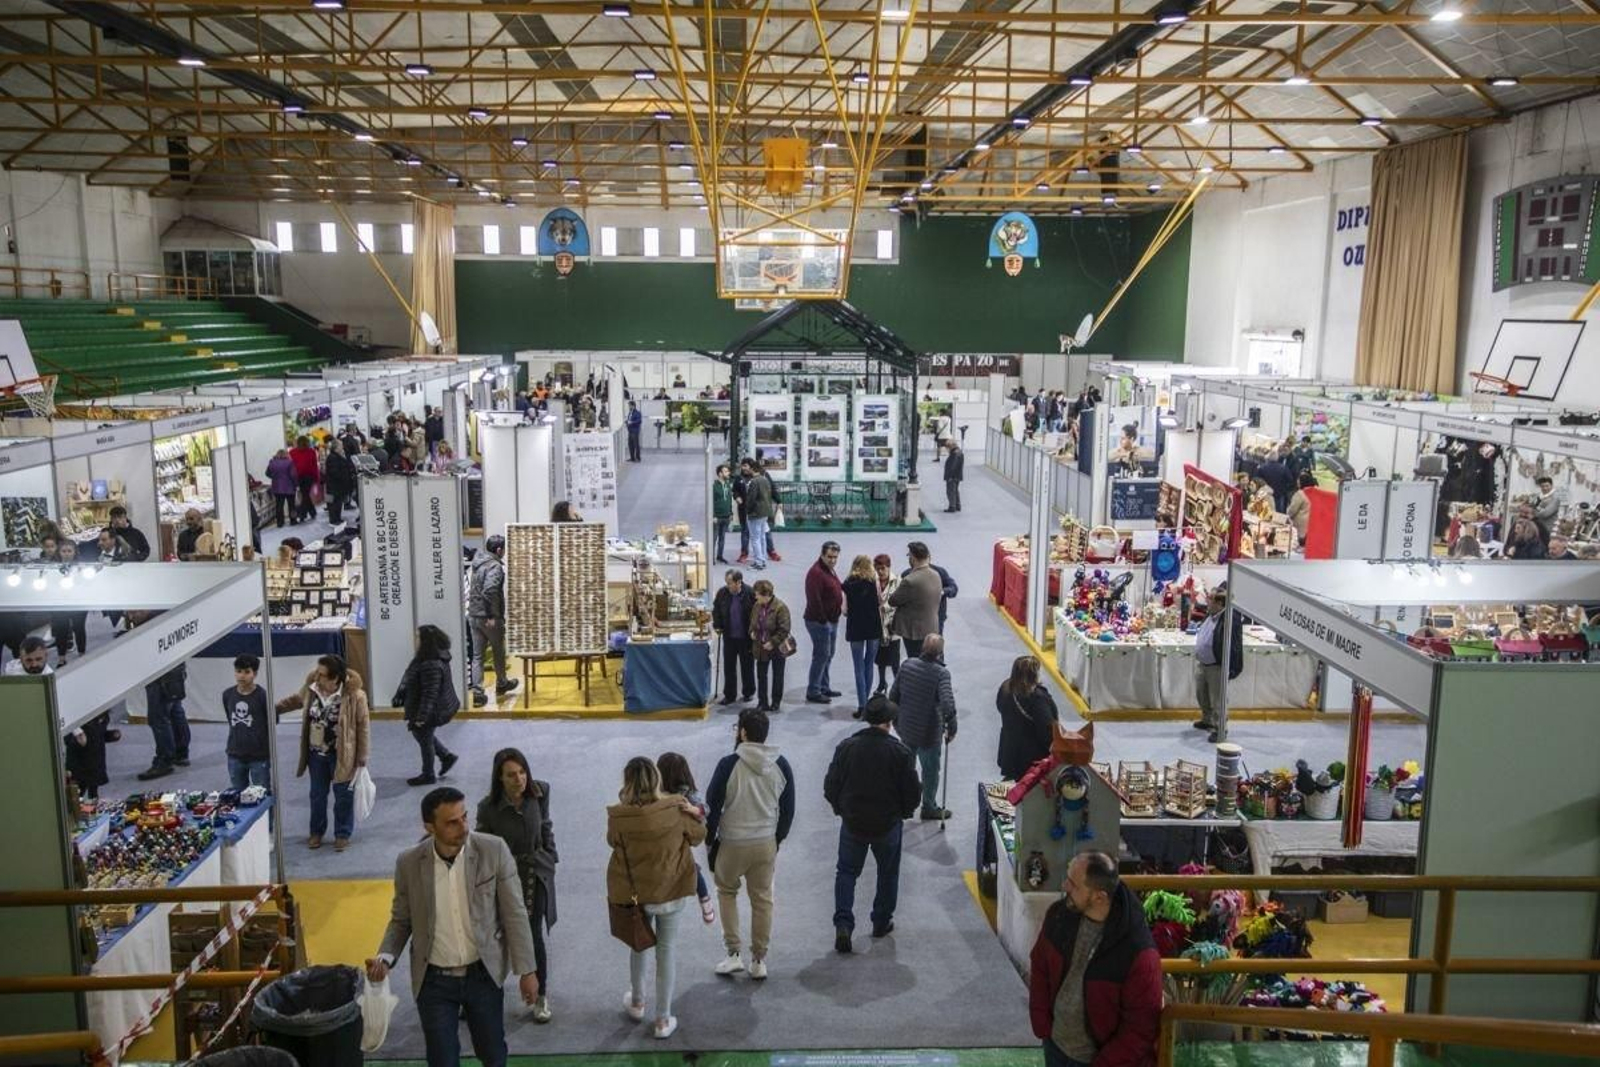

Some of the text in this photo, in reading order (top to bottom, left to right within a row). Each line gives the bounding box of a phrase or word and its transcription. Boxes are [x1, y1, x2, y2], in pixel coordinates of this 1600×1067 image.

[376, 498, 386, 528] LASER
[387, 511, 398, 548] DESEÑO
[1358, 503, 1369, 530] LE DA
[1402, 502, 1416, 534] ÉPONA
[377, 530, 386, 544] BC
[430, 497, 444, 600] EL TALLER DE LAZARO
[1402, 536, 1412, 548] DE
[378, 554, 388, 604] ARTESANÍA
[390, 558, 402, 606] CREACIÓN
[381, 608, 390, 620] BC
[158, 618, 200, 654] PLAYMOREY
[1280, 604, 1362, 660] LAS COSAS DE MI MADRE
